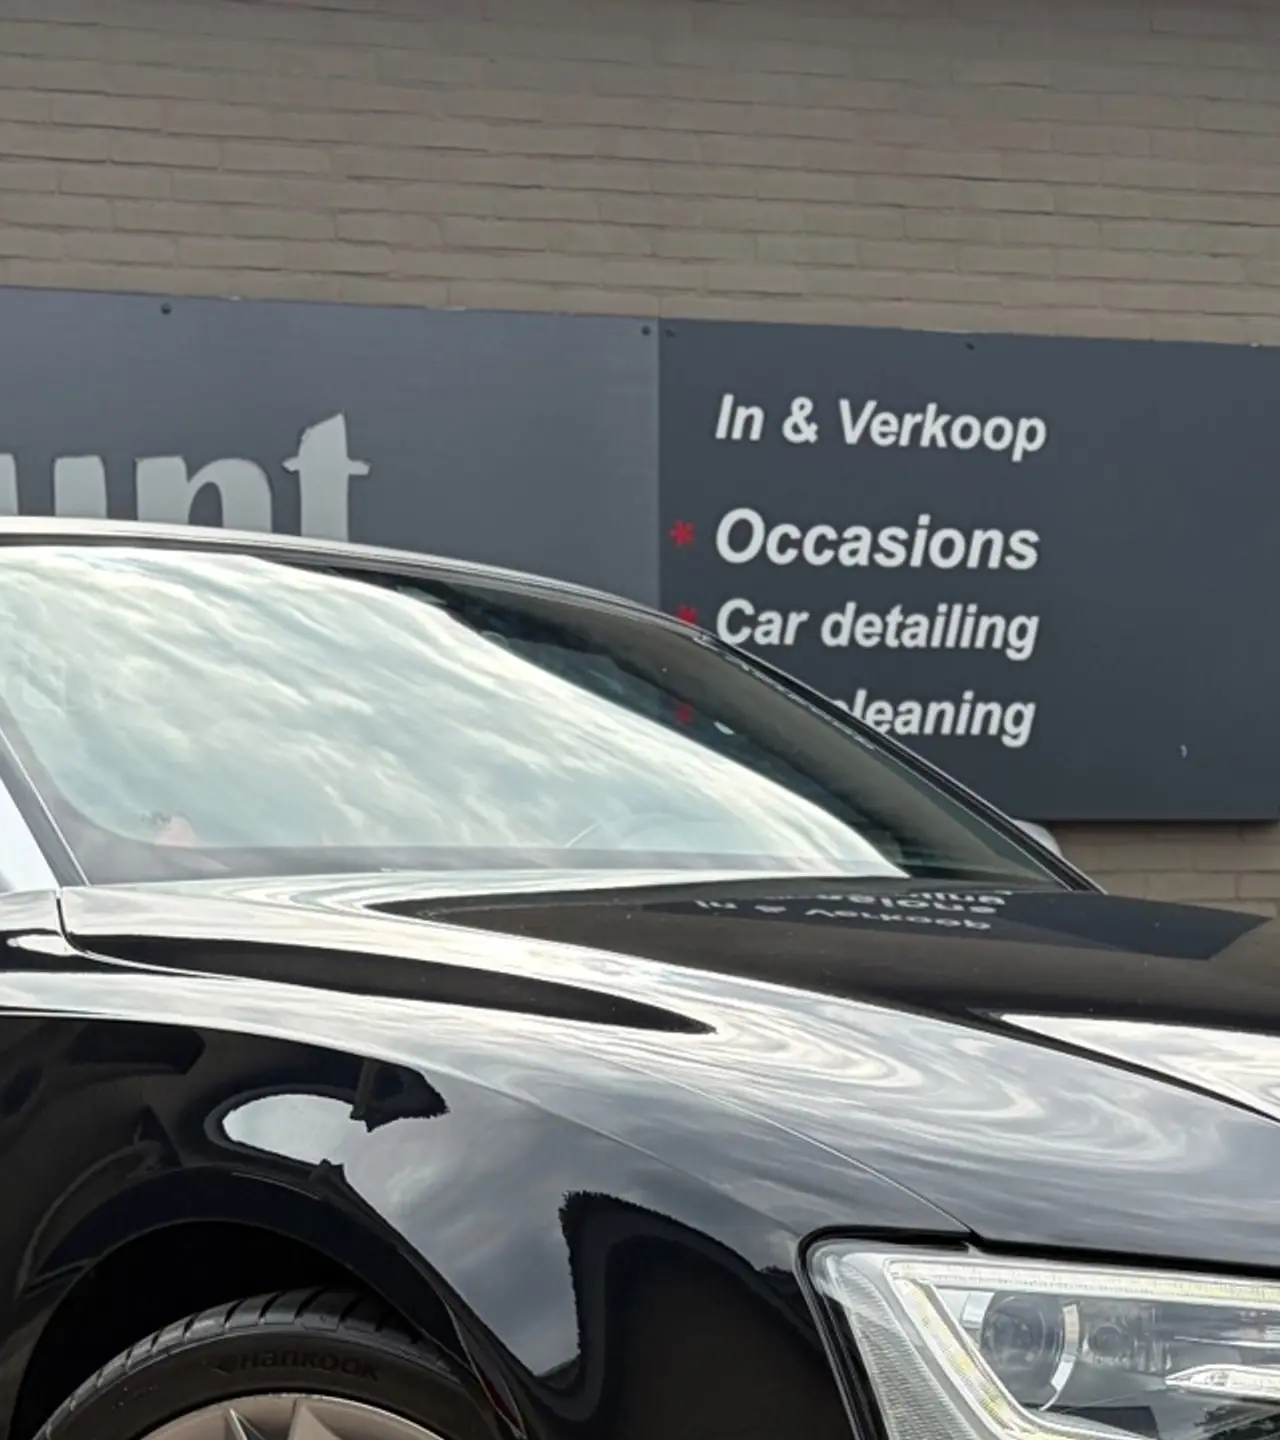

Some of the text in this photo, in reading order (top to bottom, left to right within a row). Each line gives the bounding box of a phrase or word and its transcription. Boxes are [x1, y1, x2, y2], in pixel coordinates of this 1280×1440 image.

[715, 393, 1048, 463] In & Verkoop
[714, 507, 1041, 570] Occasions
[715, 598, 1041, 662] Car detailing
